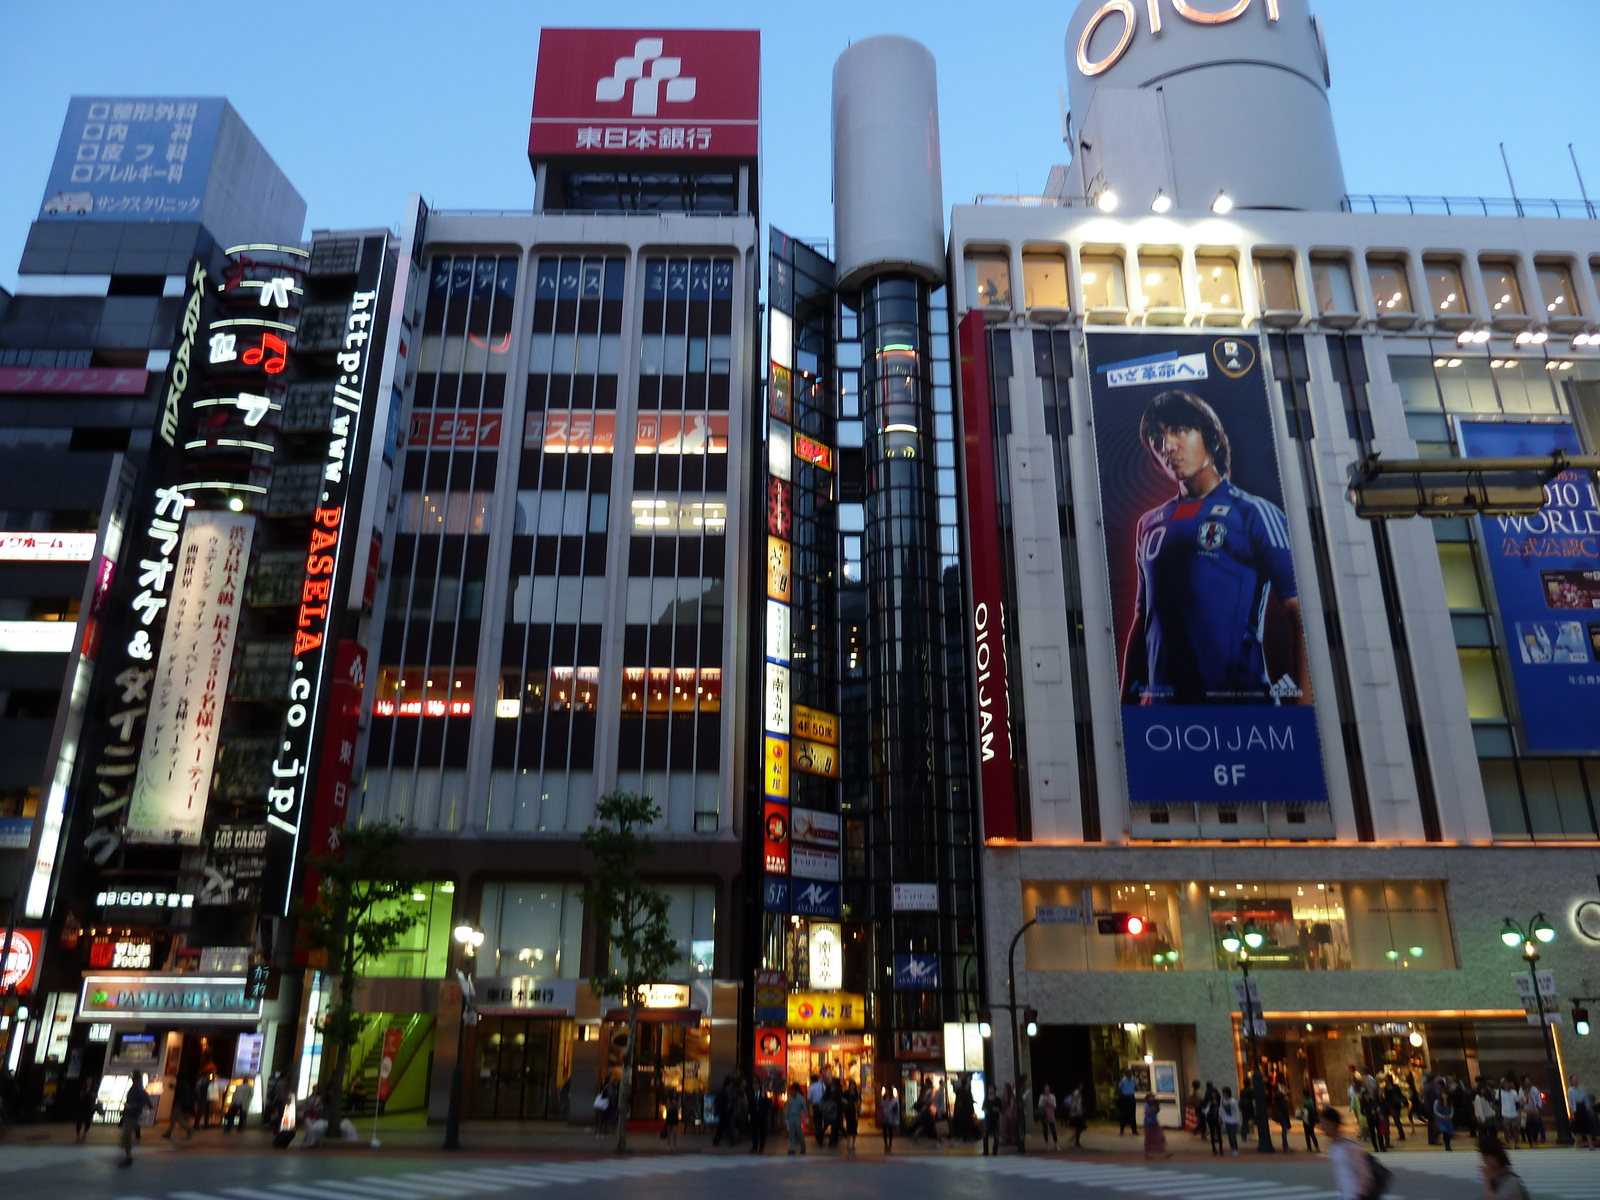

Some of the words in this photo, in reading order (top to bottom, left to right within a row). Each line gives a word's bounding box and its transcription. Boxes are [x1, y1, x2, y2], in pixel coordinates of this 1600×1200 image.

[575, 126, 712, 150] 東日本銀行
[95, 163, 184, 184] アレルギー科
[97, 194, 200, 213] サンクスクリニック
[540, 275, 600, 291] ハウス
[650, 276, 729, 292] ミスパリ
[160, 260, 207, 448] KARAOKE
[1110, 362, 1205, 384] いざ革命へ。
[437, 420, 499, 441] ジェイ
[1269, 686, 1303, 698] adidas
[1227, 725, 1295, 751] JAM
[1213, 763, 1246, 787] 6F
[213, 830, 233, 849] LOS
[767, 883, 788, 905] 5F
[820, 1002, 853, 1019] 松屋
